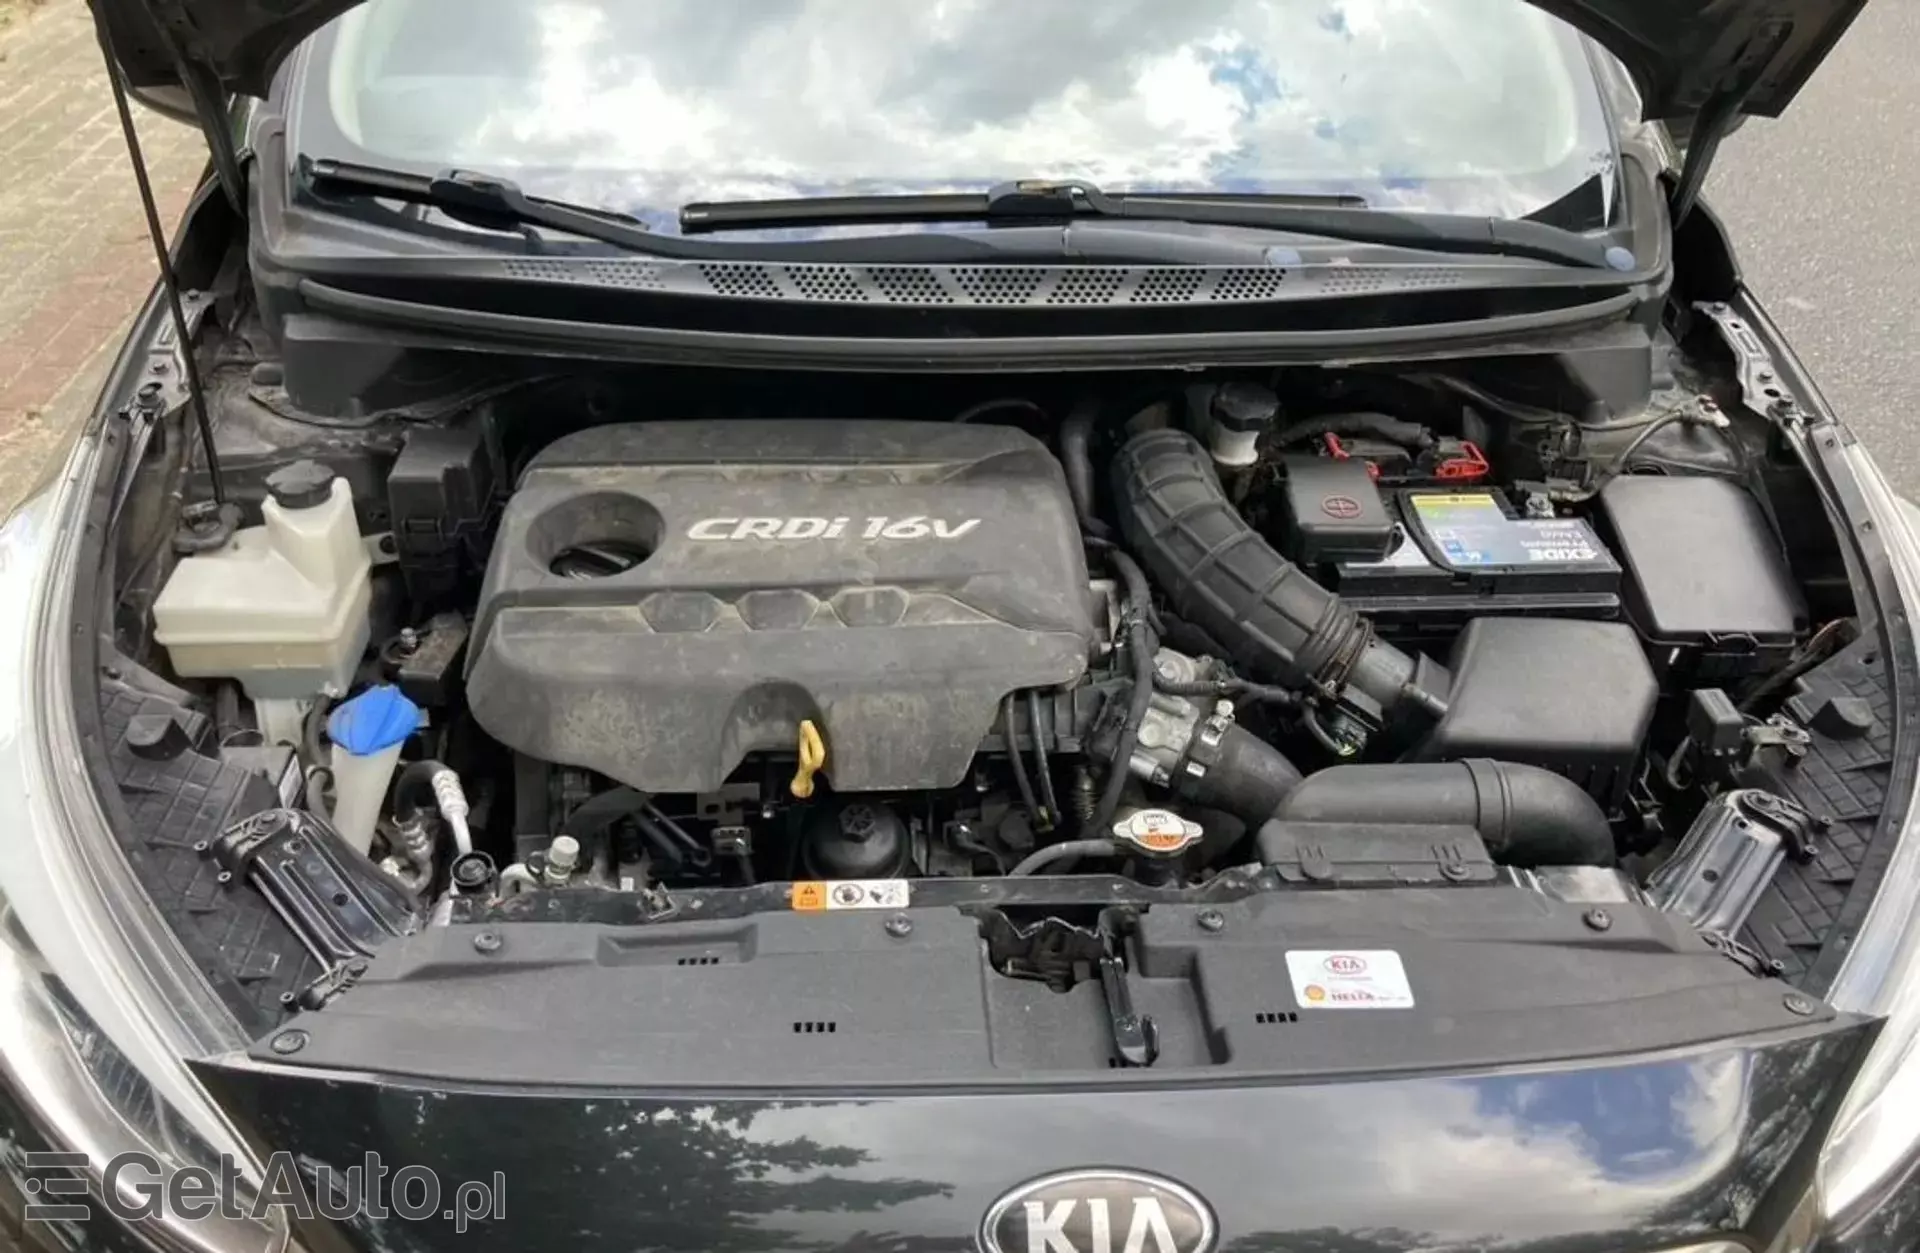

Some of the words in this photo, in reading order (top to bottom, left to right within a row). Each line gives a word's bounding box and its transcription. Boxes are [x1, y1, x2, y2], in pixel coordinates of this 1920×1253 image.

[686, 516, 851, 540] CRDi
[861, 515, 983, 539] 16V
[1528, 549, 1598, 561] EXIDE
[1331, 960, 1360, 969] KIA
[1023, 1197, 1177, 1253] KIA
